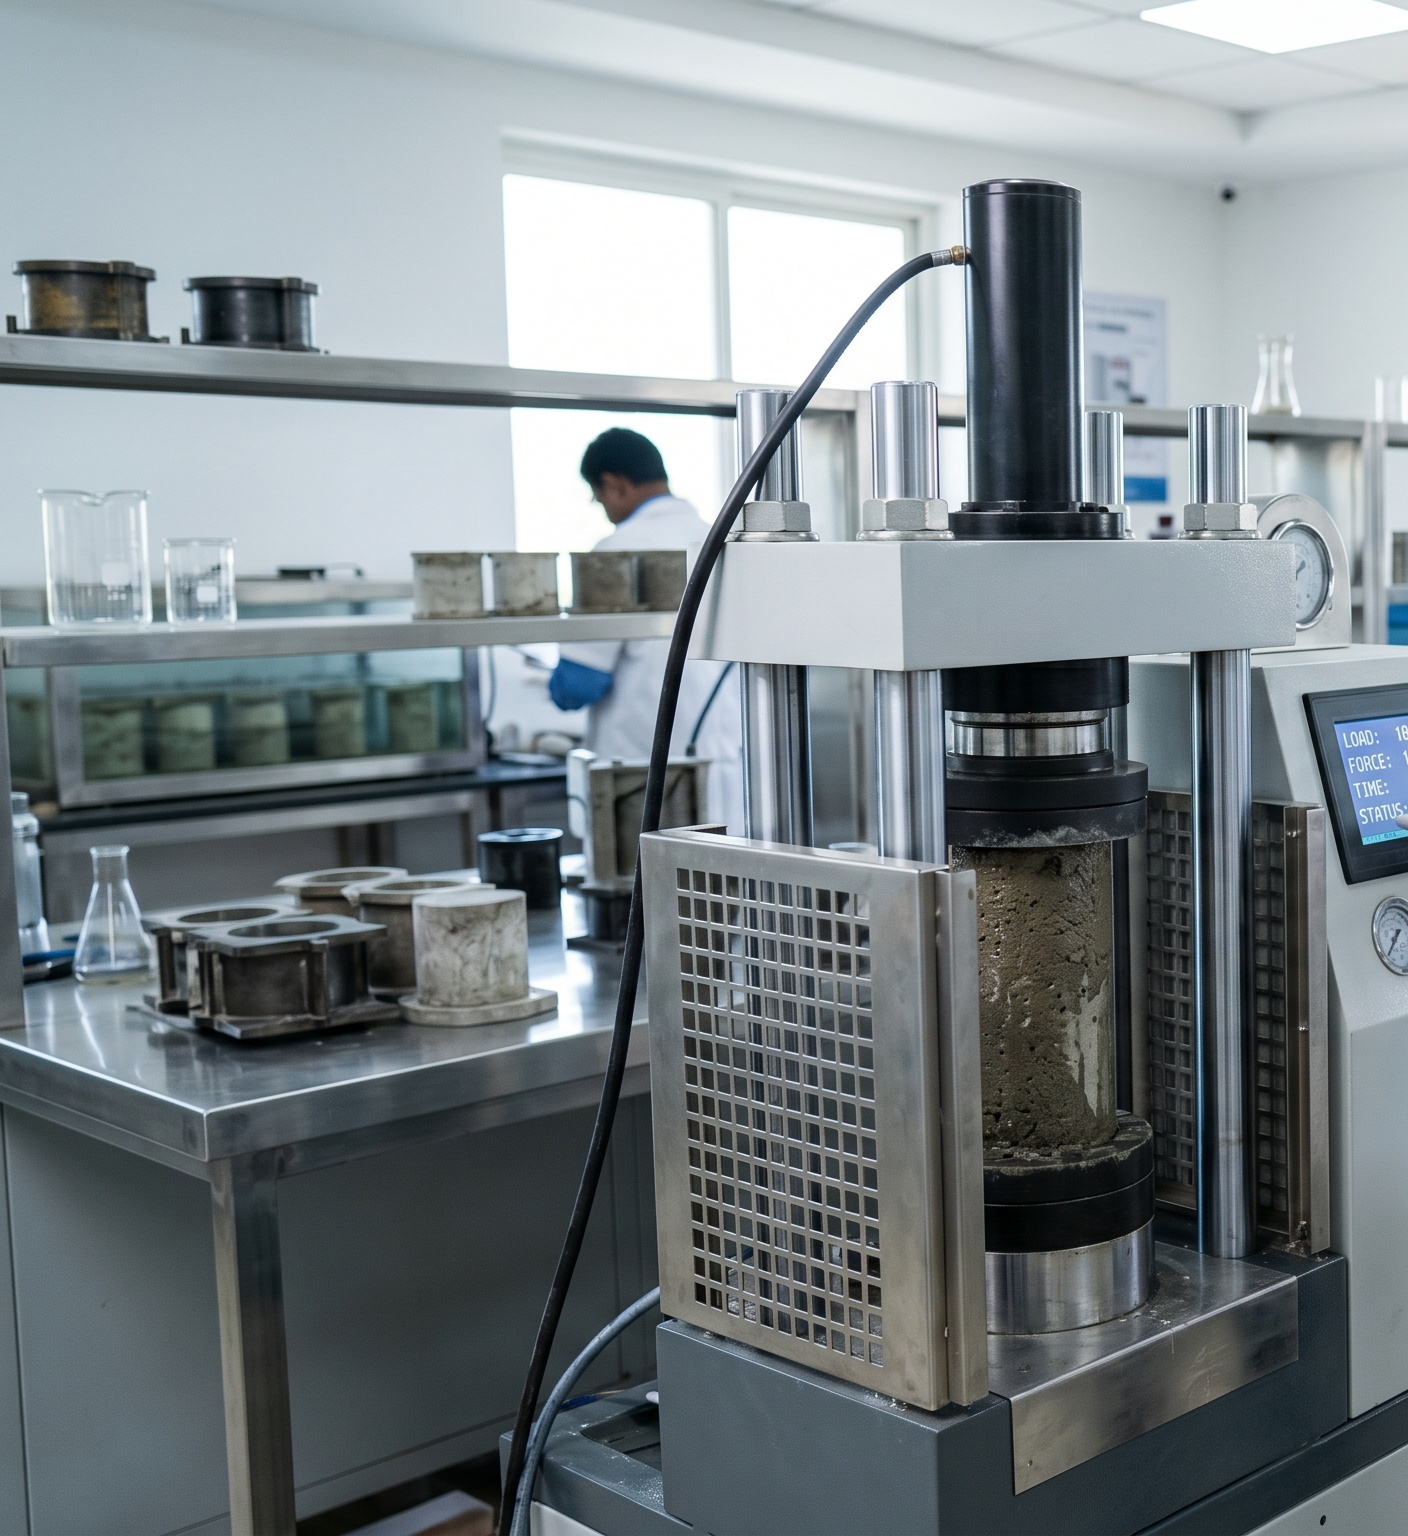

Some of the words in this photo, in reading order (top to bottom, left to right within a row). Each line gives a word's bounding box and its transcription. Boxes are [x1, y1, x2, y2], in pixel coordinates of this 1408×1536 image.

[1343, 730, 1380, 748] LOAD:
[1348, 753, 1392, 773] FORCE:
[1353, 779, 1389, 798] TIME:
